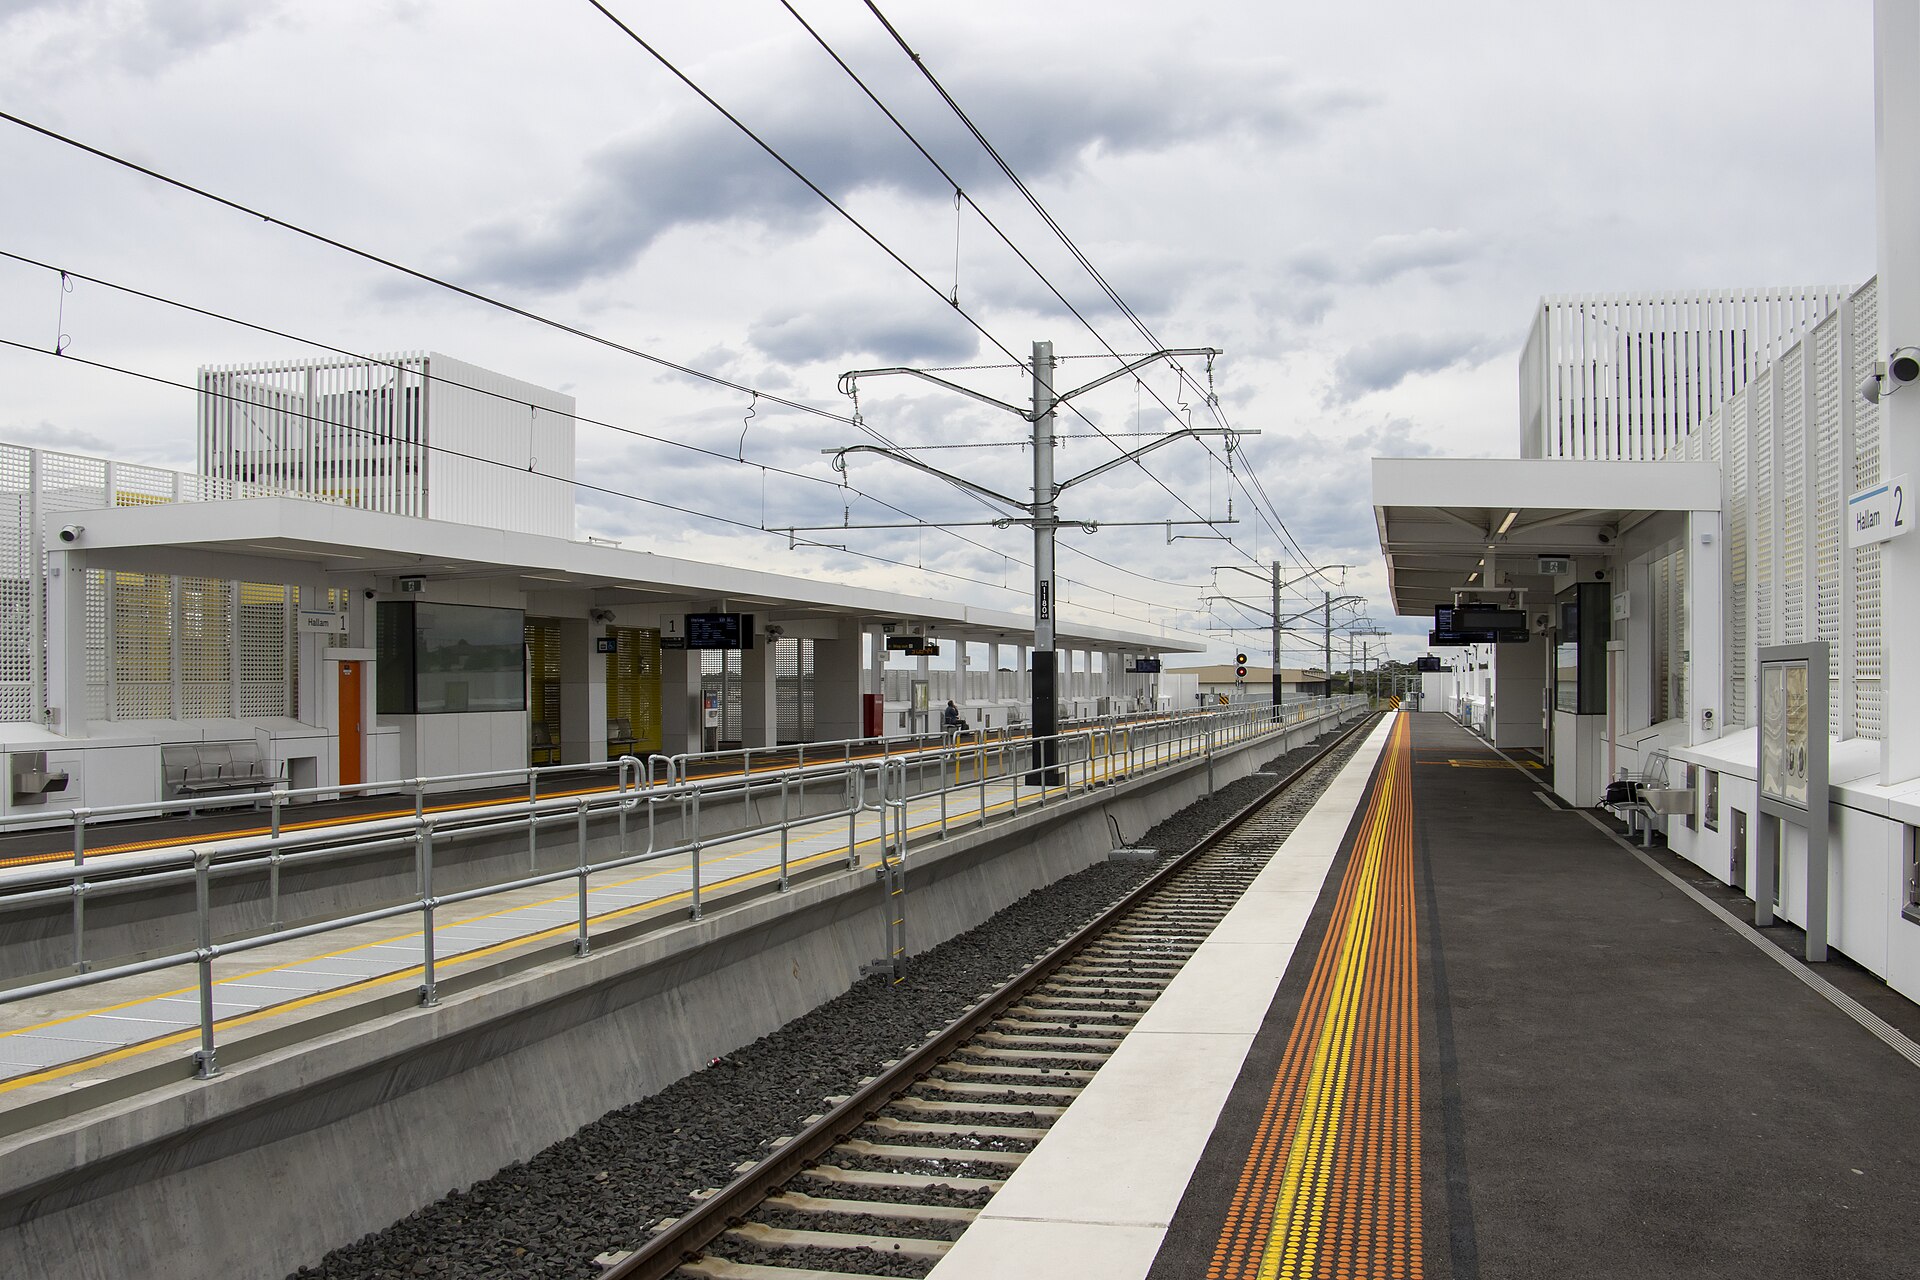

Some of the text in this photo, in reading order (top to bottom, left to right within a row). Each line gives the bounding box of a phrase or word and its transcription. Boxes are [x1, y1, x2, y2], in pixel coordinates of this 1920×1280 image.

[1856, 485, 1903, 532] Hallam 2
[307, 615, 346, 631] Hallam 1
[669, 620, 676, 633] 1
